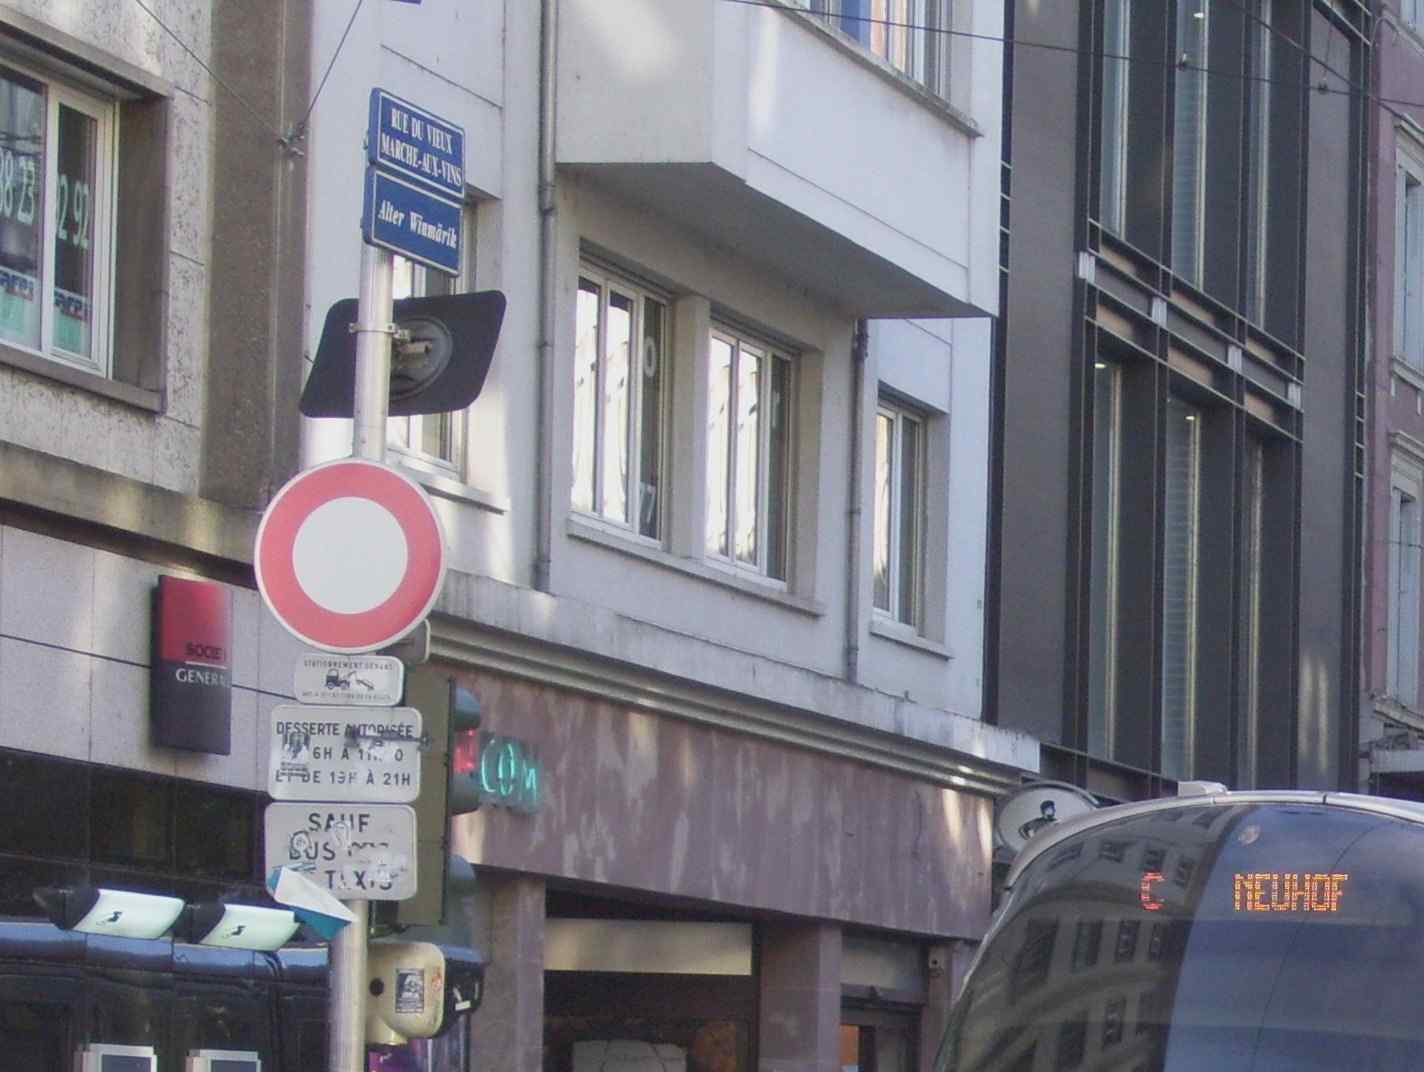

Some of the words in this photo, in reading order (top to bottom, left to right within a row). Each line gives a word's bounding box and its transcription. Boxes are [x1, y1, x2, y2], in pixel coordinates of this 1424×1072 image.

[391, 108, 409, 134] RUE
[411, 117, 424, 141] DU
[426, 123, 453, 155] VIEUX
[377, 199, 405, 228] Alter
[276, 721, 341, 736] DESSERTE
[312, 746, 333, 760] 6H
[383, 773, 411, 786] 21H
[1139, 871, 1167, 911] C
[1233, 872, 1349, 912] NEUHOF
